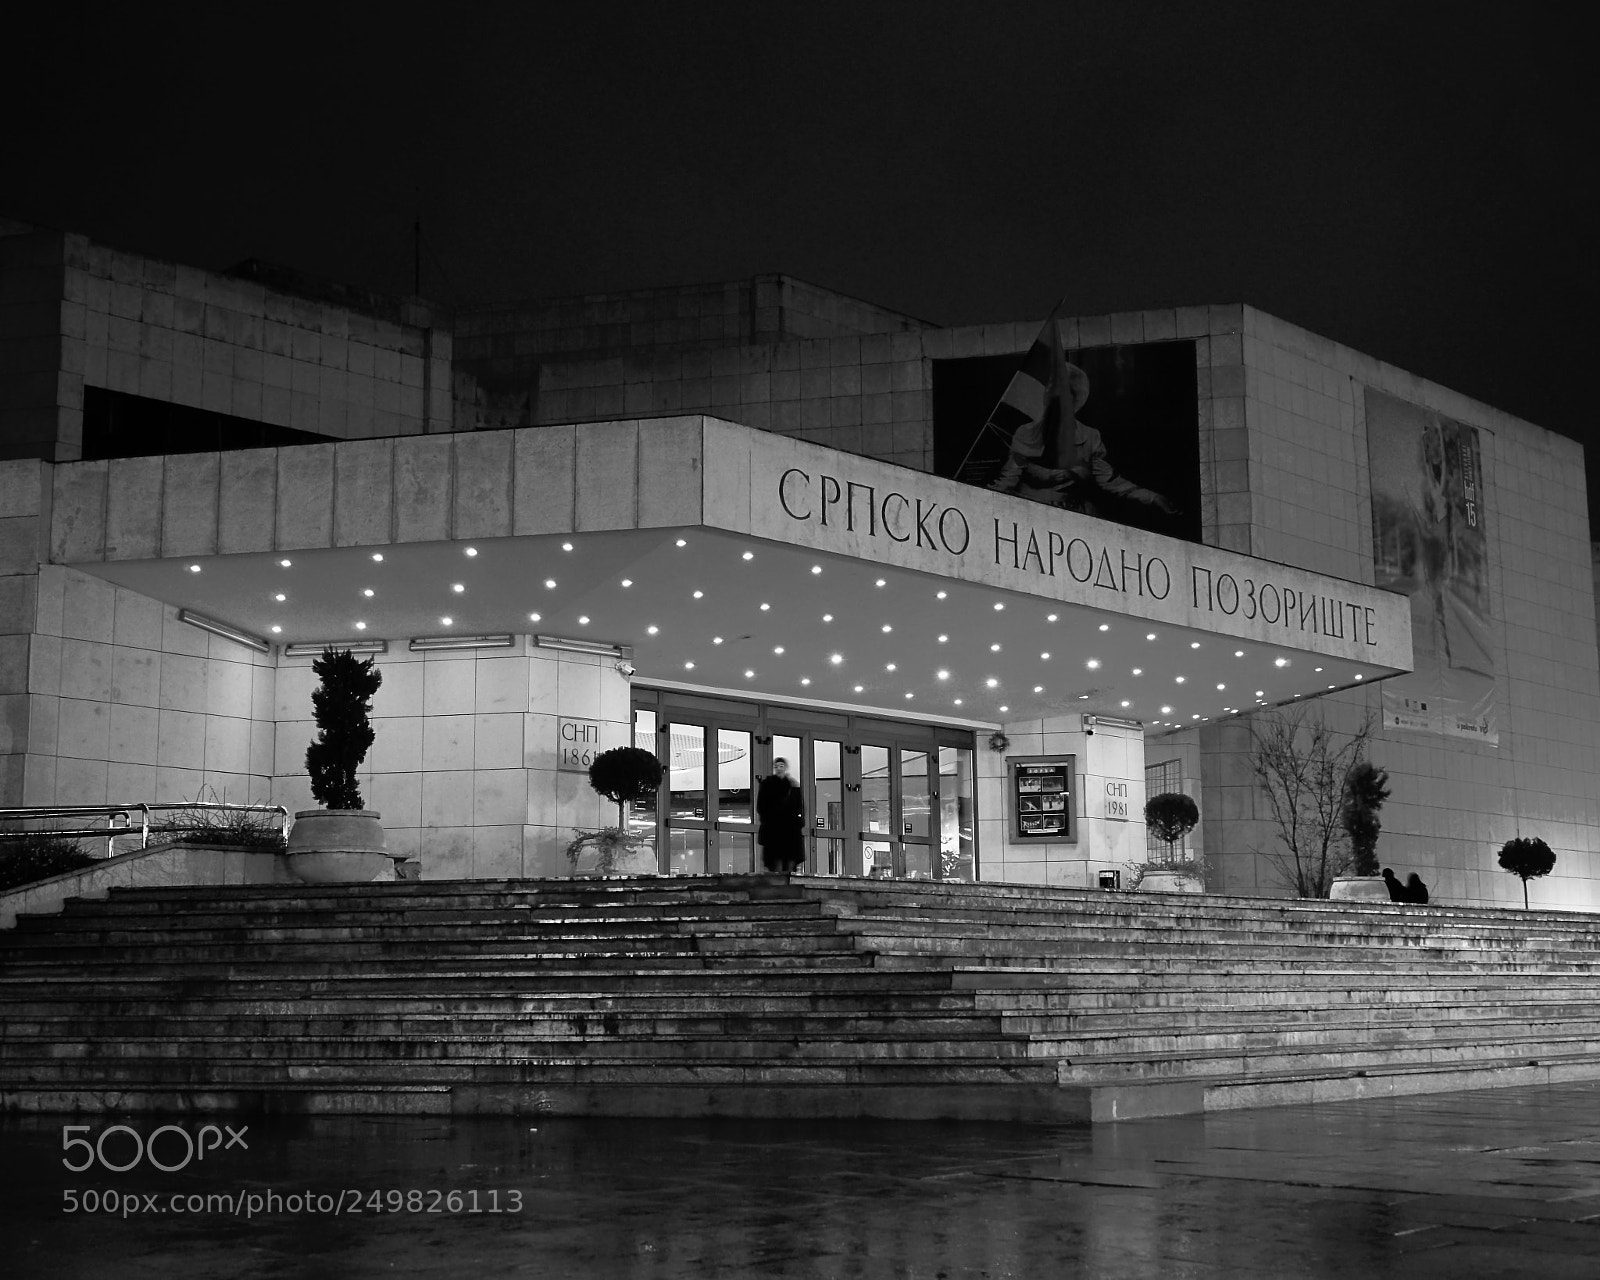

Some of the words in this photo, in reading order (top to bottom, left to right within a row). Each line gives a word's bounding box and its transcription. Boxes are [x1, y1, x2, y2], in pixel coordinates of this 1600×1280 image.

[1466, 501, 1477, 527] 15
[778, 468, 970, 556] СРПСКО
[993, 517, 1171, 600] НАРОДНО
[1191, 565, 1377, 647] ПОЗОРИШТЕ
[561, 723, 598, 743] СНП
[1106, 782, 1128, 797] СНП
[1107, 801, 1128, 816] 1981
